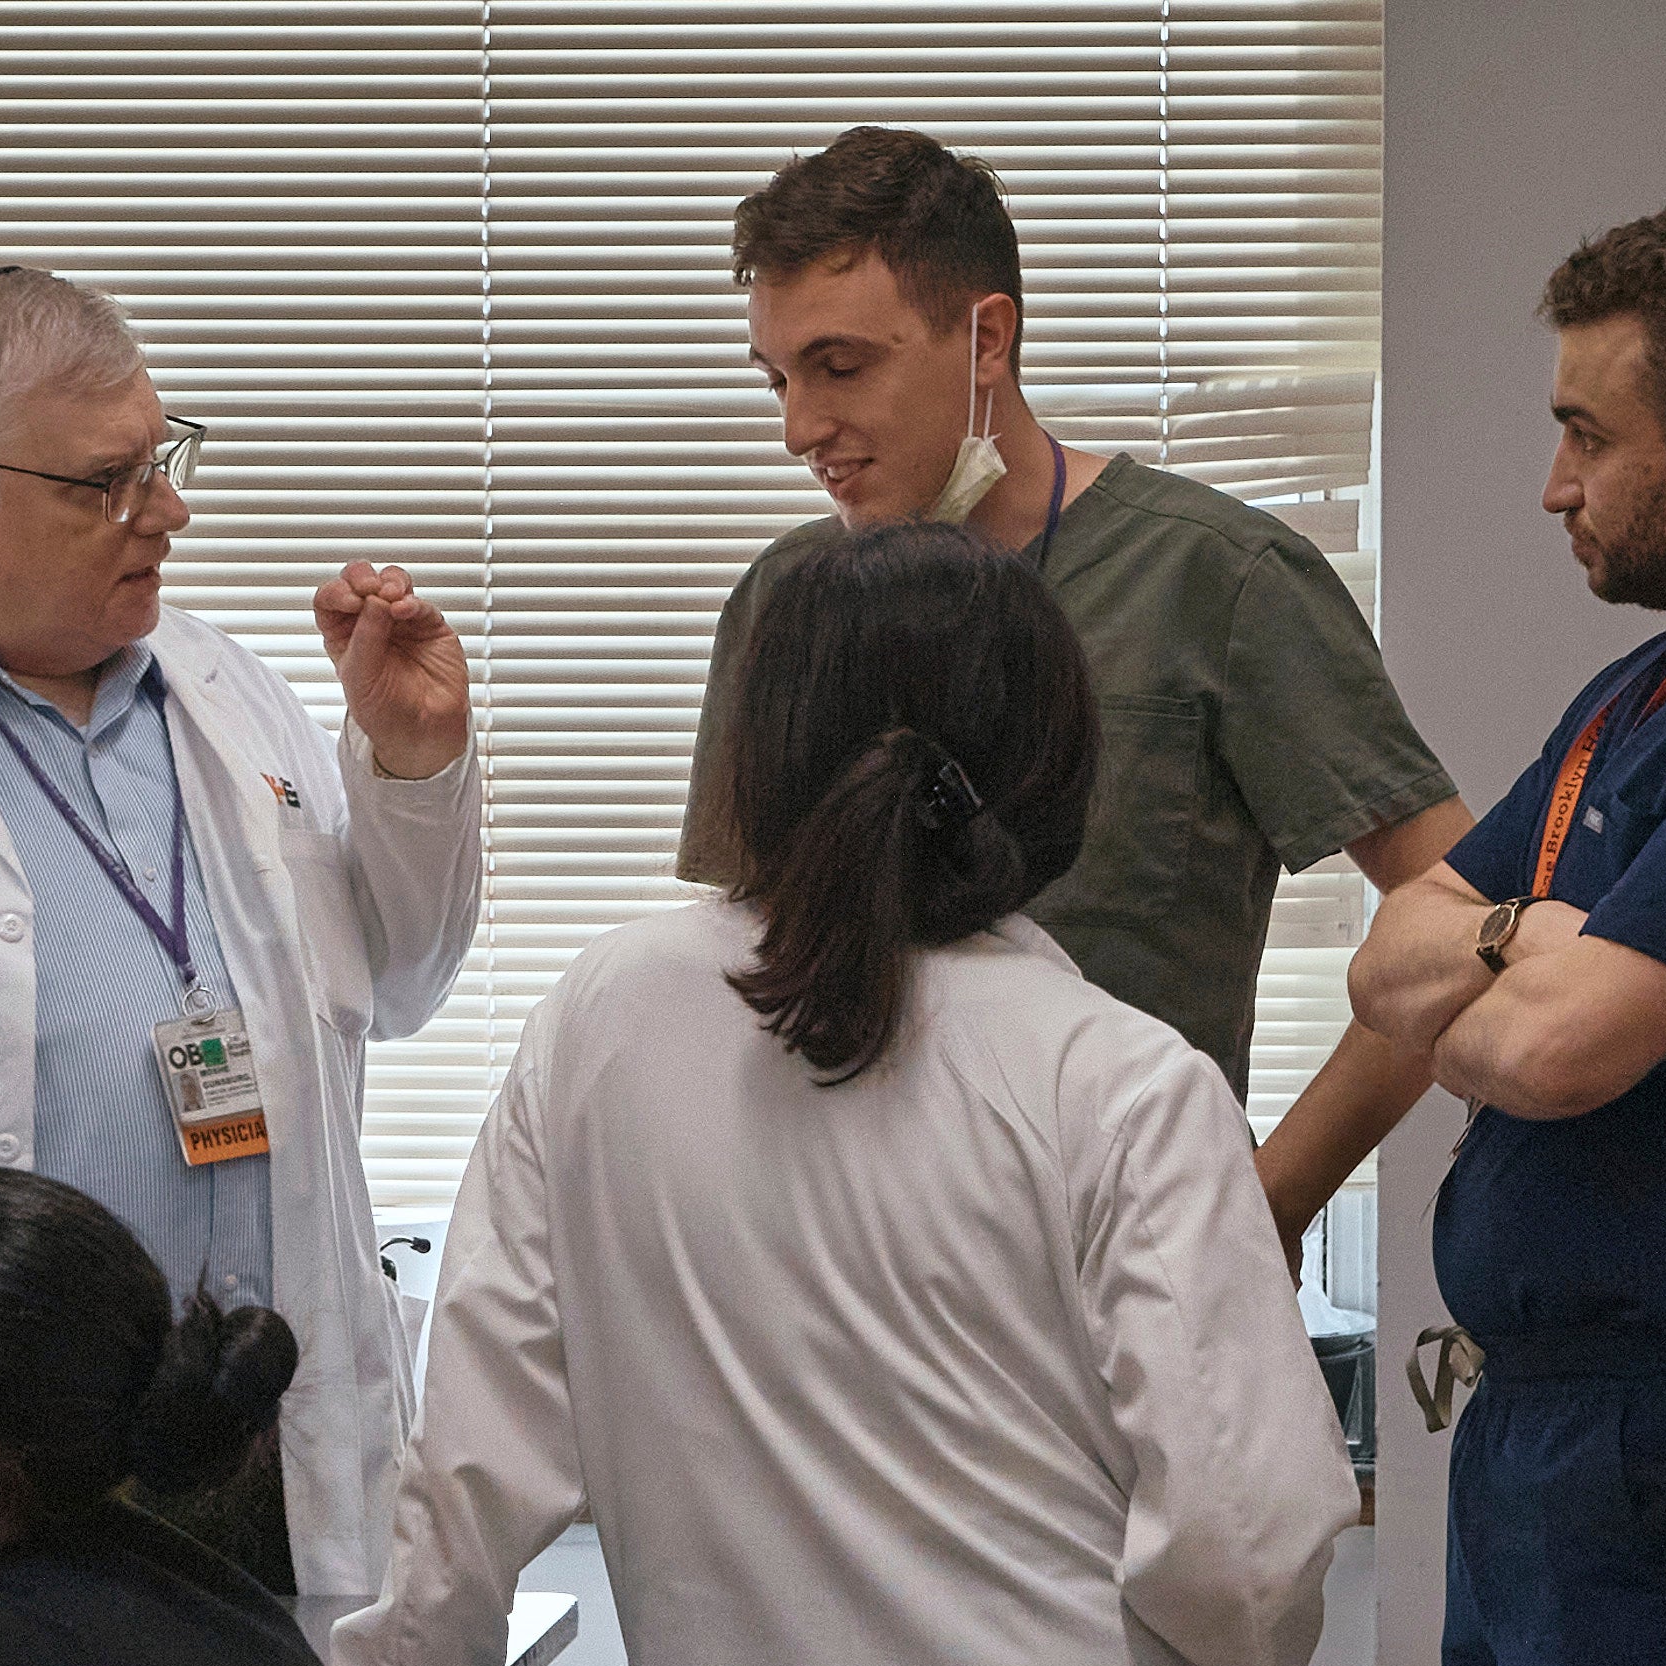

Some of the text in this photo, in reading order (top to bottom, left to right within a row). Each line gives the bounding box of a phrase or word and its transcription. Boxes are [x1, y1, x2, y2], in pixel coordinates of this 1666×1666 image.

[1546, 760, 1590, 855] Brooklyn
[169, 1043, 205, 1069] OB
[190, 1121, 266, 1151] PHYSICIA
